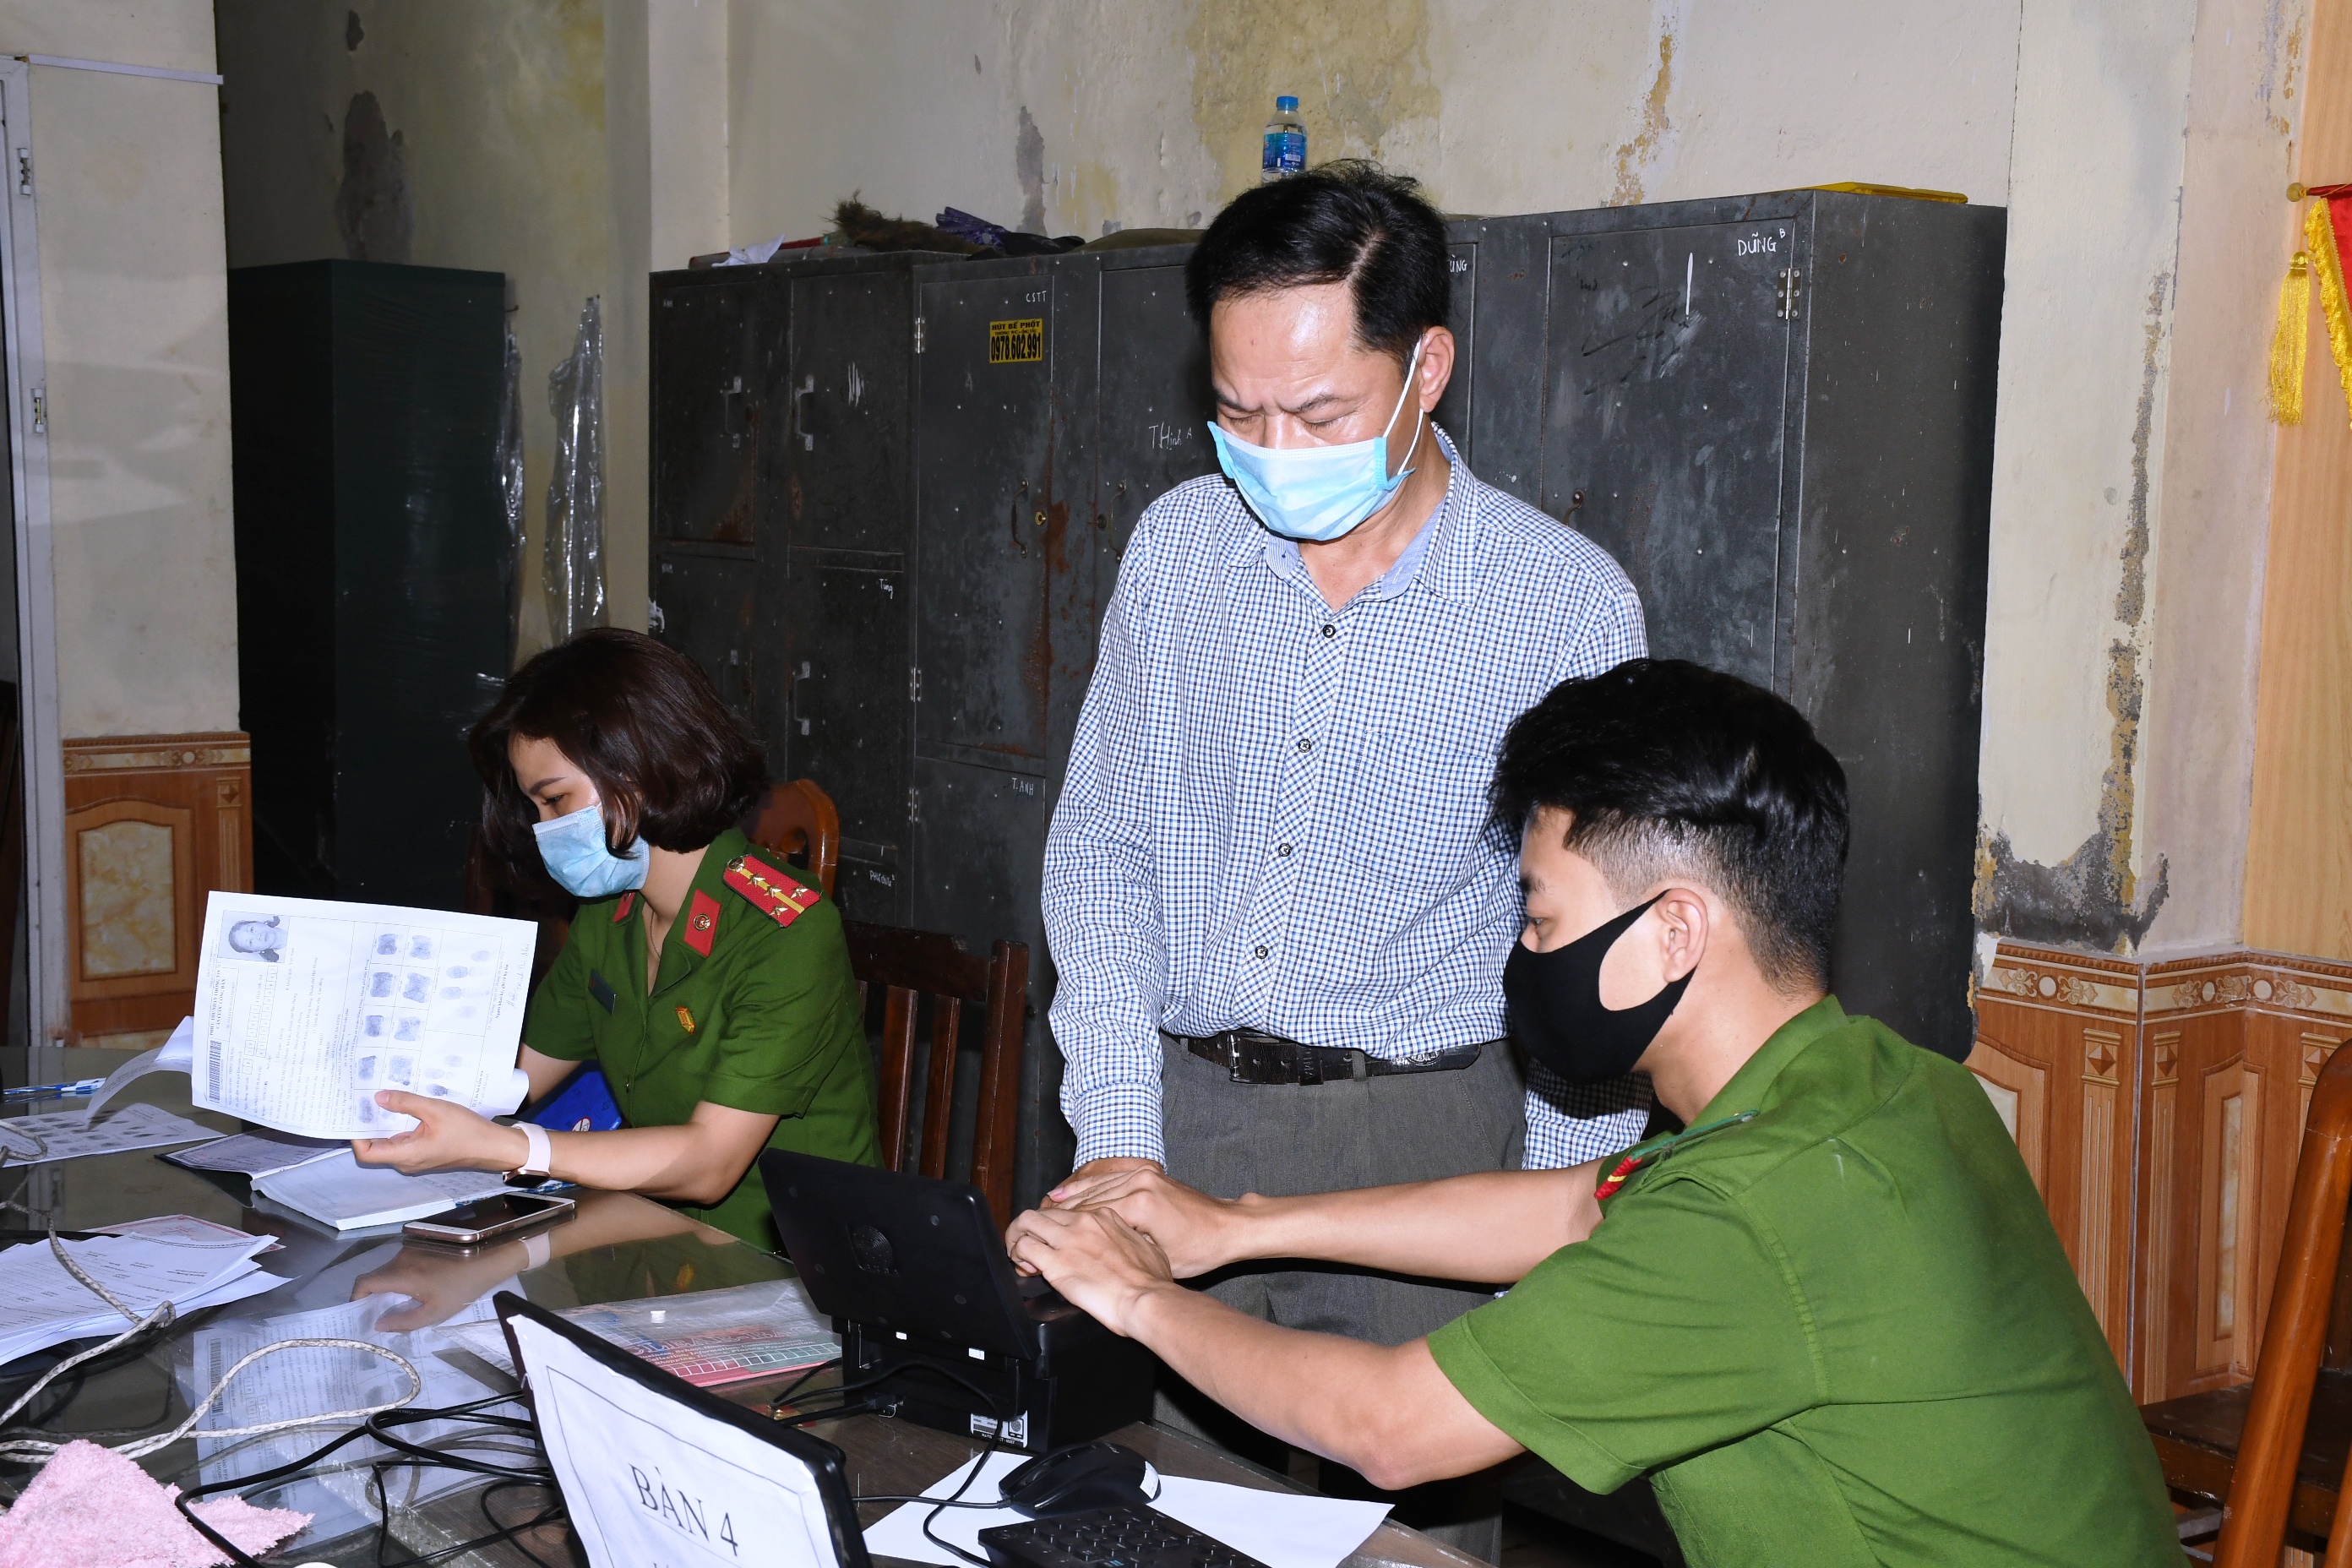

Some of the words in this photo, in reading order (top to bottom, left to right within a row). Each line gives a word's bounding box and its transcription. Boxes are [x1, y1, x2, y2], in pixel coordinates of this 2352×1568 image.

[1738, 231, 1777, 256] DŨNG
[1449, 254, 1468, 273] ÙNG
[1026, 290, 1048, 303] CSTT
[991, 333, 1041, 362] 0978.602.991
[628, 1462, 710, 1544] BÀN
[721, 1512, 738, 1557] 4
